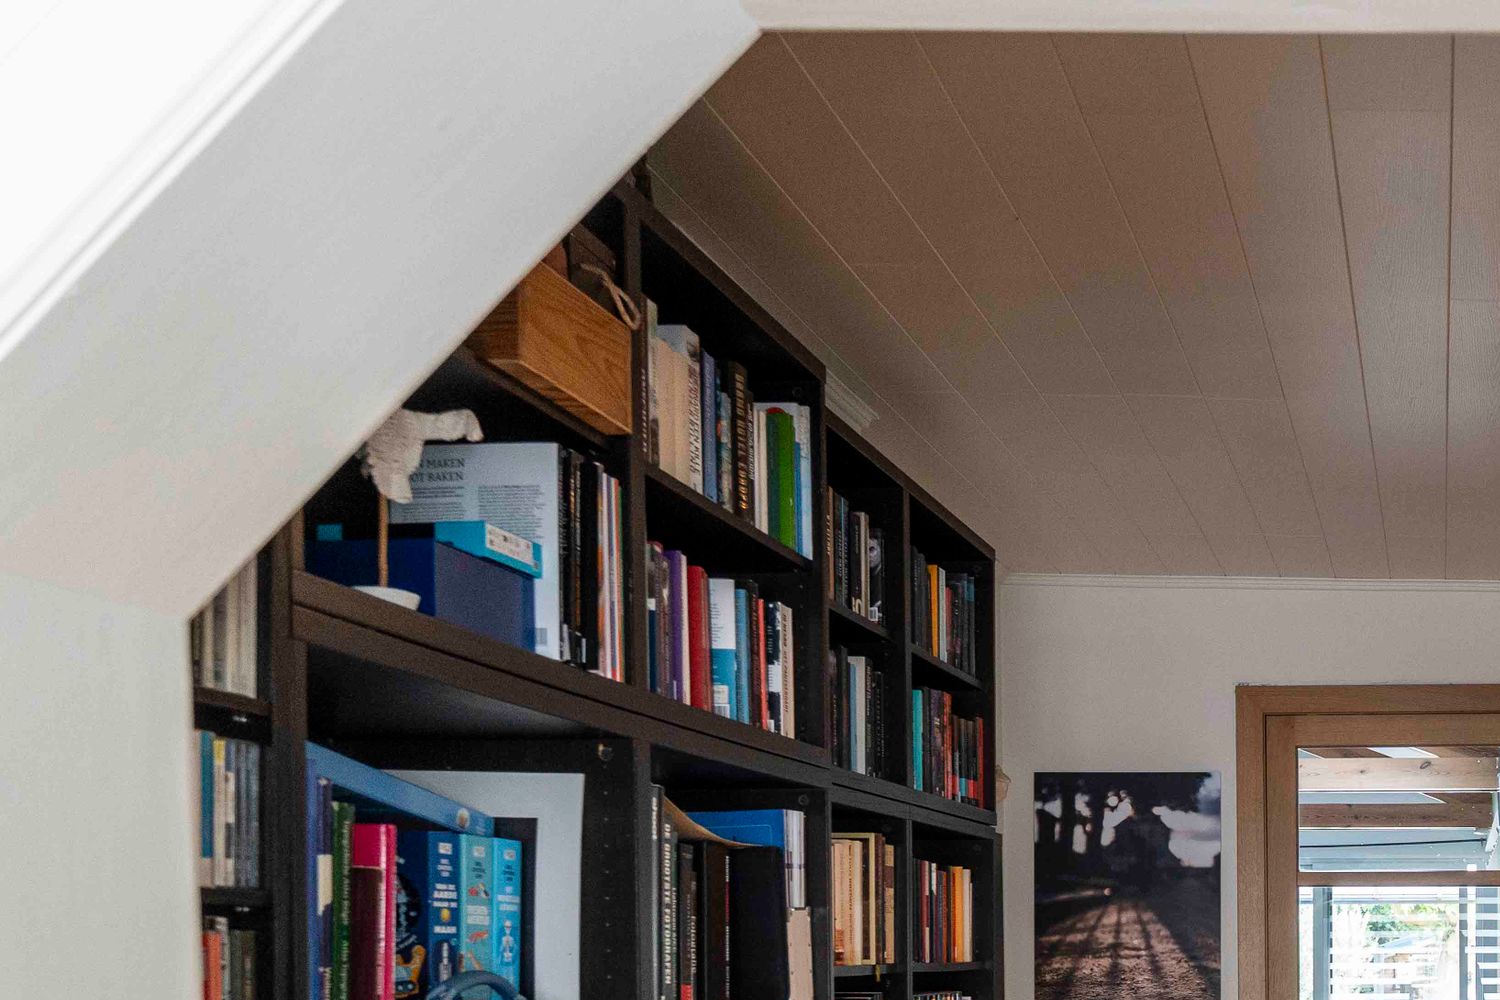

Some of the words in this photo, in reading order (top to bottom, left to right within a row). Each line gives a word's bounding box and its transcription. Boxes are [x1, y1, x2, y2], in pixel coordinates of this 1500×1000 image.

[735, 374, 746, 417] GRAND
[736, 418, 747, 458] HOTEL
[427, 457, 465, 468] MAKEN
[737, 460, 749, 511] EUROPA
[664, 823, 671, 838] DE
[664, 908, 672, 985] FOTOGRAFEN
